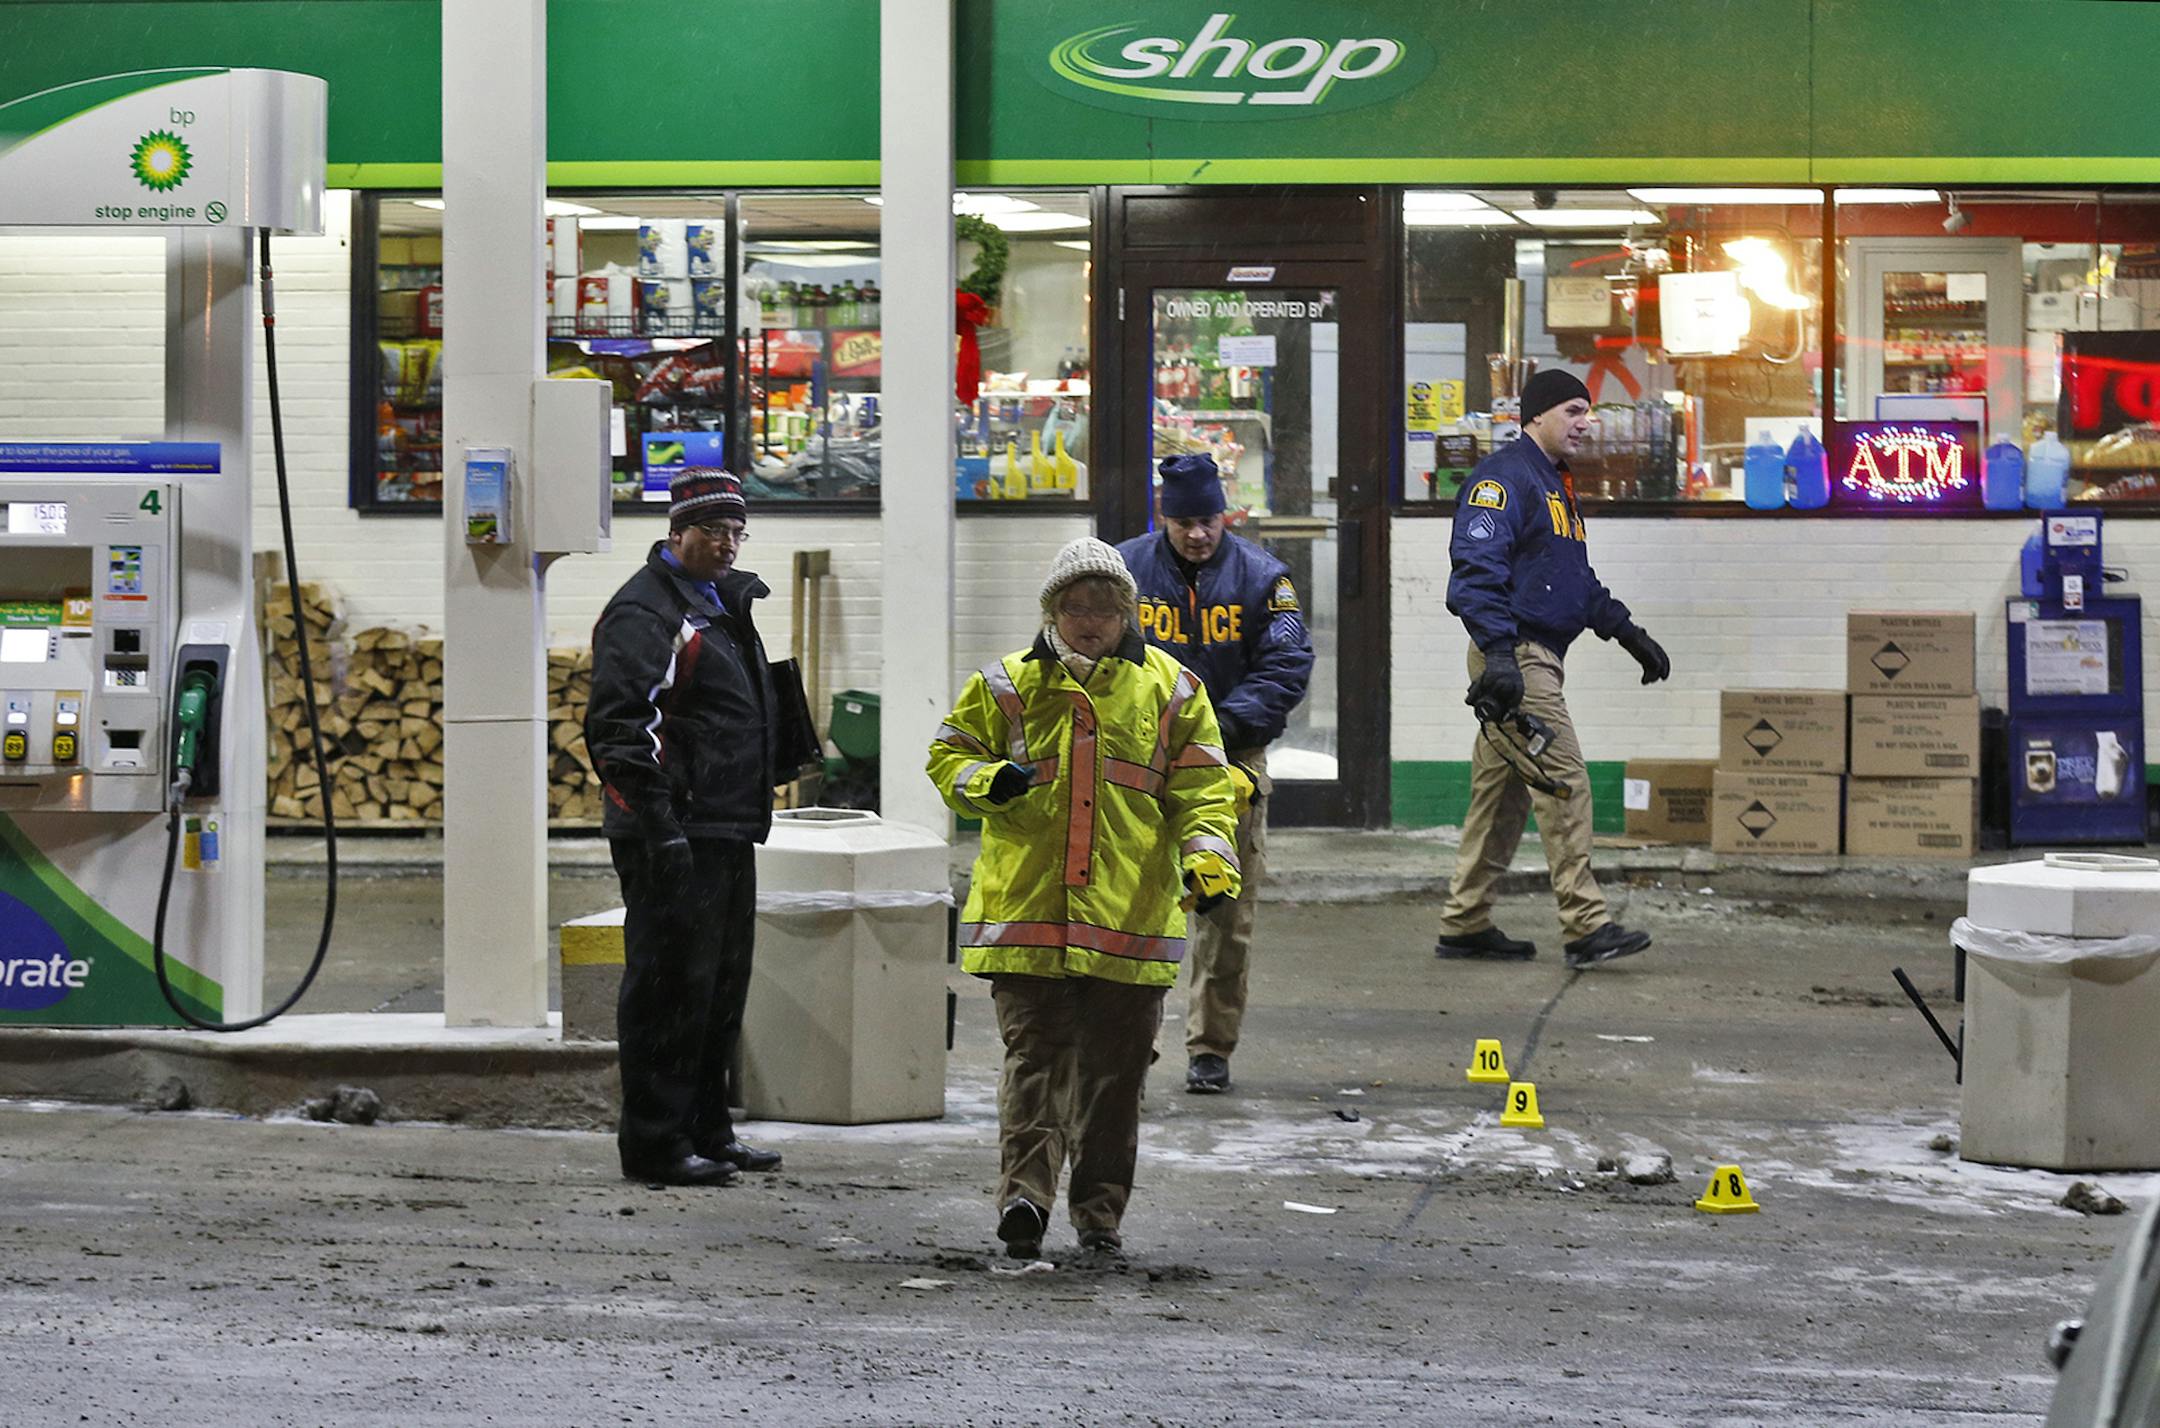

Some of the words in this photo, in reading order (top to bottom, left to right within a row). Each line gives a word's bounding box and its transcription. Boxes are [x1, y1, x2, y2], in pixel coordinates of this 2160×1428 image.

[1120, 14, 1405, 104] shop
[170, 107, 195, 127] bp
[95, 205, 132, 220] stop
[138, 204, 196, 221] engine
[1166, 302, 1210, 317] OWNED
[1216, 302, 1238, 317] AND
[1244, 302, 1305, 317] OPERATED
[1309, 302, 1324, 317] BY
[1842, 440, 1967, 490] ATM
[139, 489, 162, 515] 4
[1138, 604, 1243, 645] POLICE
[1479, 1050, 1499, 1070] 10
[1515, 1090, 1528, 1112] 9
[1730, 1173, 1742, 1197] 8
